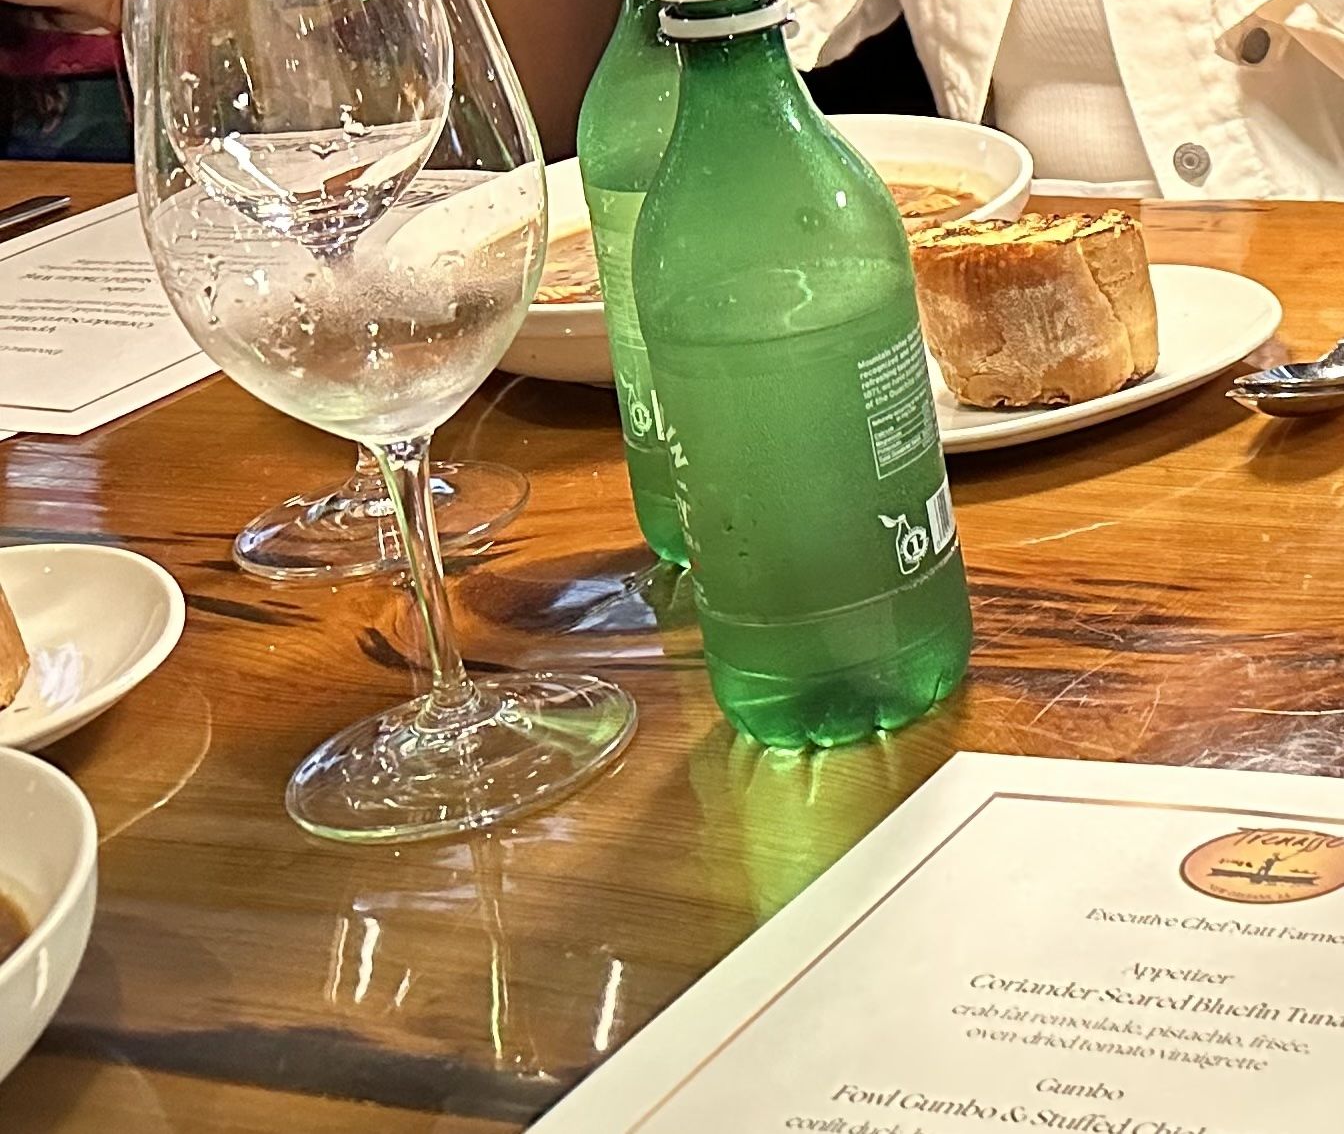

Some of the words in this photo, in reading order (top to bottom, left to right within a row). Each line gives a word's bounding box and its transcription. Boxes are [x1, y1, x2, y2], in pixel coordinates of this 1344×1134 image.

[1085, 907, 1179, 928] Executive
[1181, 916, 1231, 933] Chef
[1228, 920, 1275, 938] Matt
[1121, 962, 1236, 985] Appetizer
[970, 972, 1099, 1002] Coriander
[1099, 986, 1195, 1012] Seared
[1192, 996, 1281, 1021] Bluefin
[951, 1003, 999, 1018] crab
[999, 1006, 1030, 1022] fat
[1030, 1013, 1143, 1037] remoulade,
[1078, 1038, 1155, 1059] tomato
[1159, 1048, 1269, 1071] vinaigrette
[1036, 1077, 1125, 1101] Gumbo
[831, 1083, 902, 1107] Fowl
[899, 1092, 999, 1119] Gumbo
[1000, 1106, 1029, 1124] &
[1030, 1108, 1133, 1134] Stuffed
